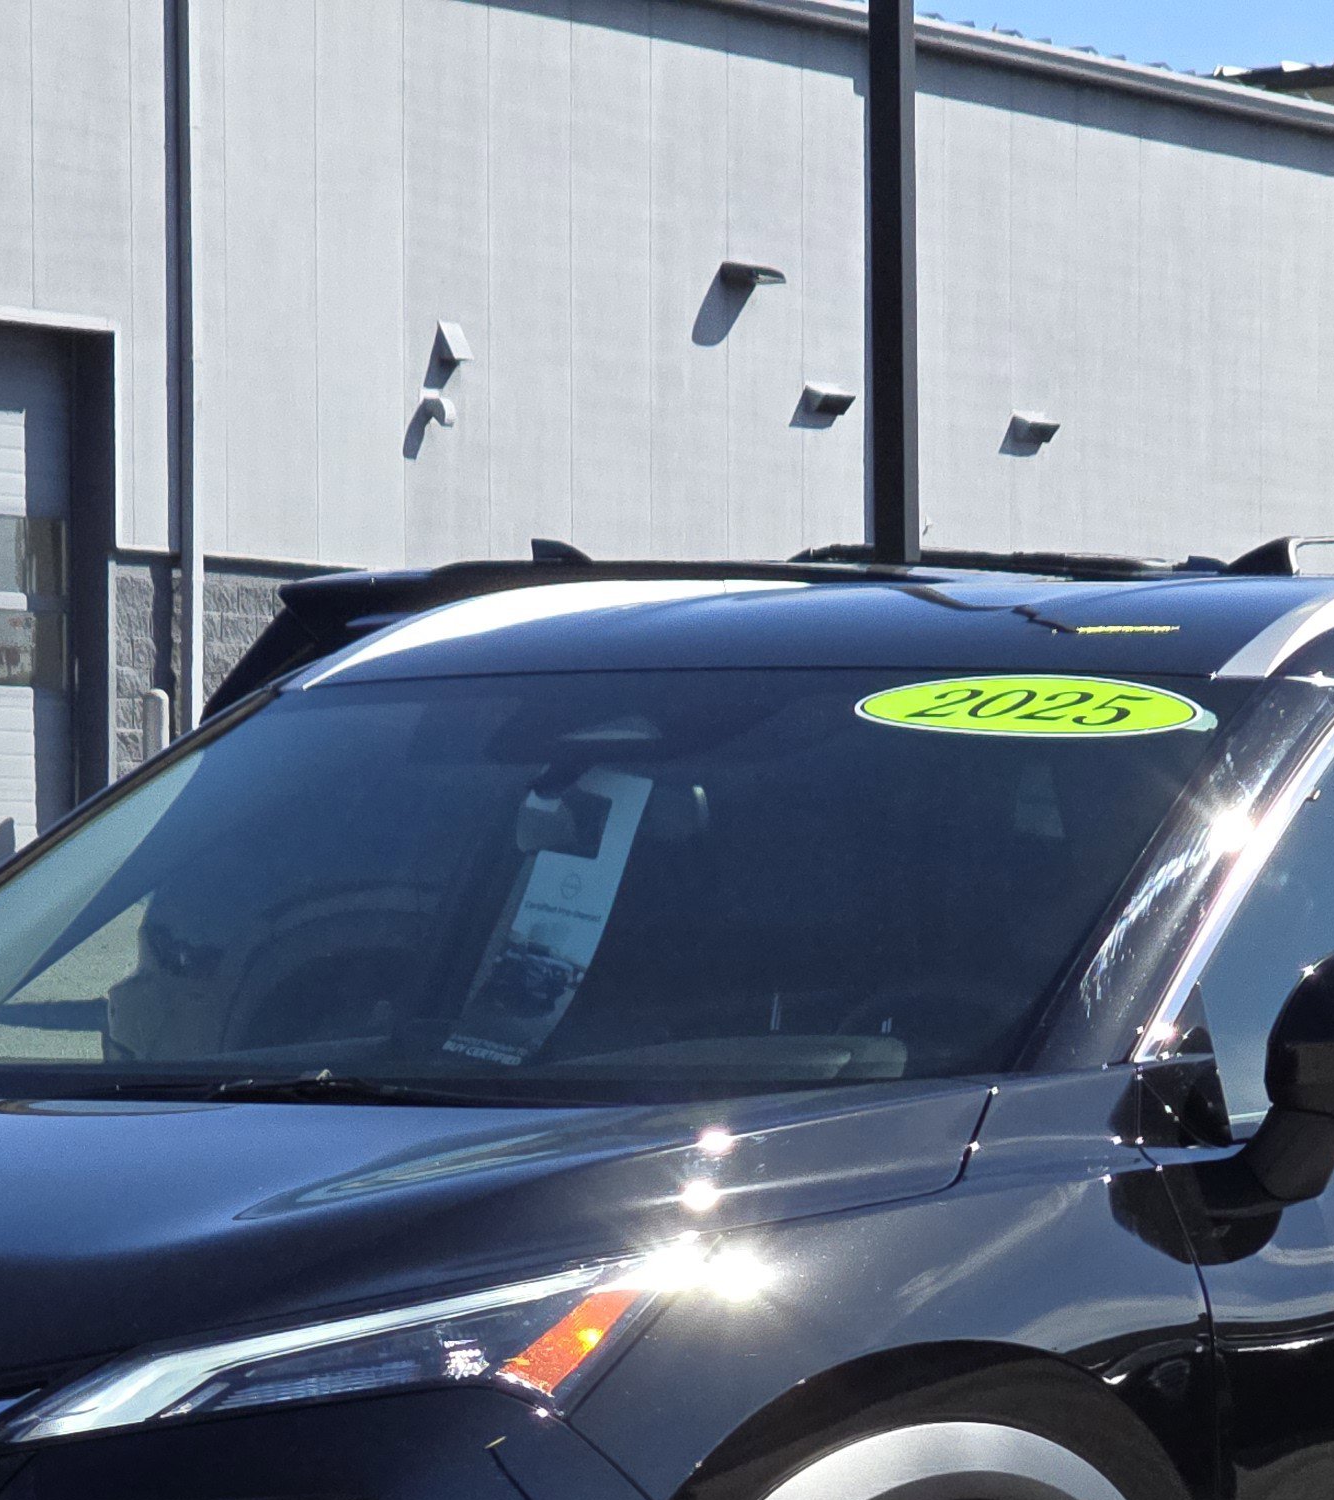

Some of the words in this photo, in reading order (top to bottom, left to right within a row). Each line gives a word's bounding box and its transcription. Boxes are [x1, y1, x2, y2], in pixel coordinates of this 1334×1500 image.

[906, 689, 1153, 726] 2025
[442, 1040, 466, 1052] BUY
[466, 1046, 522, 1066] CERTIFIED
